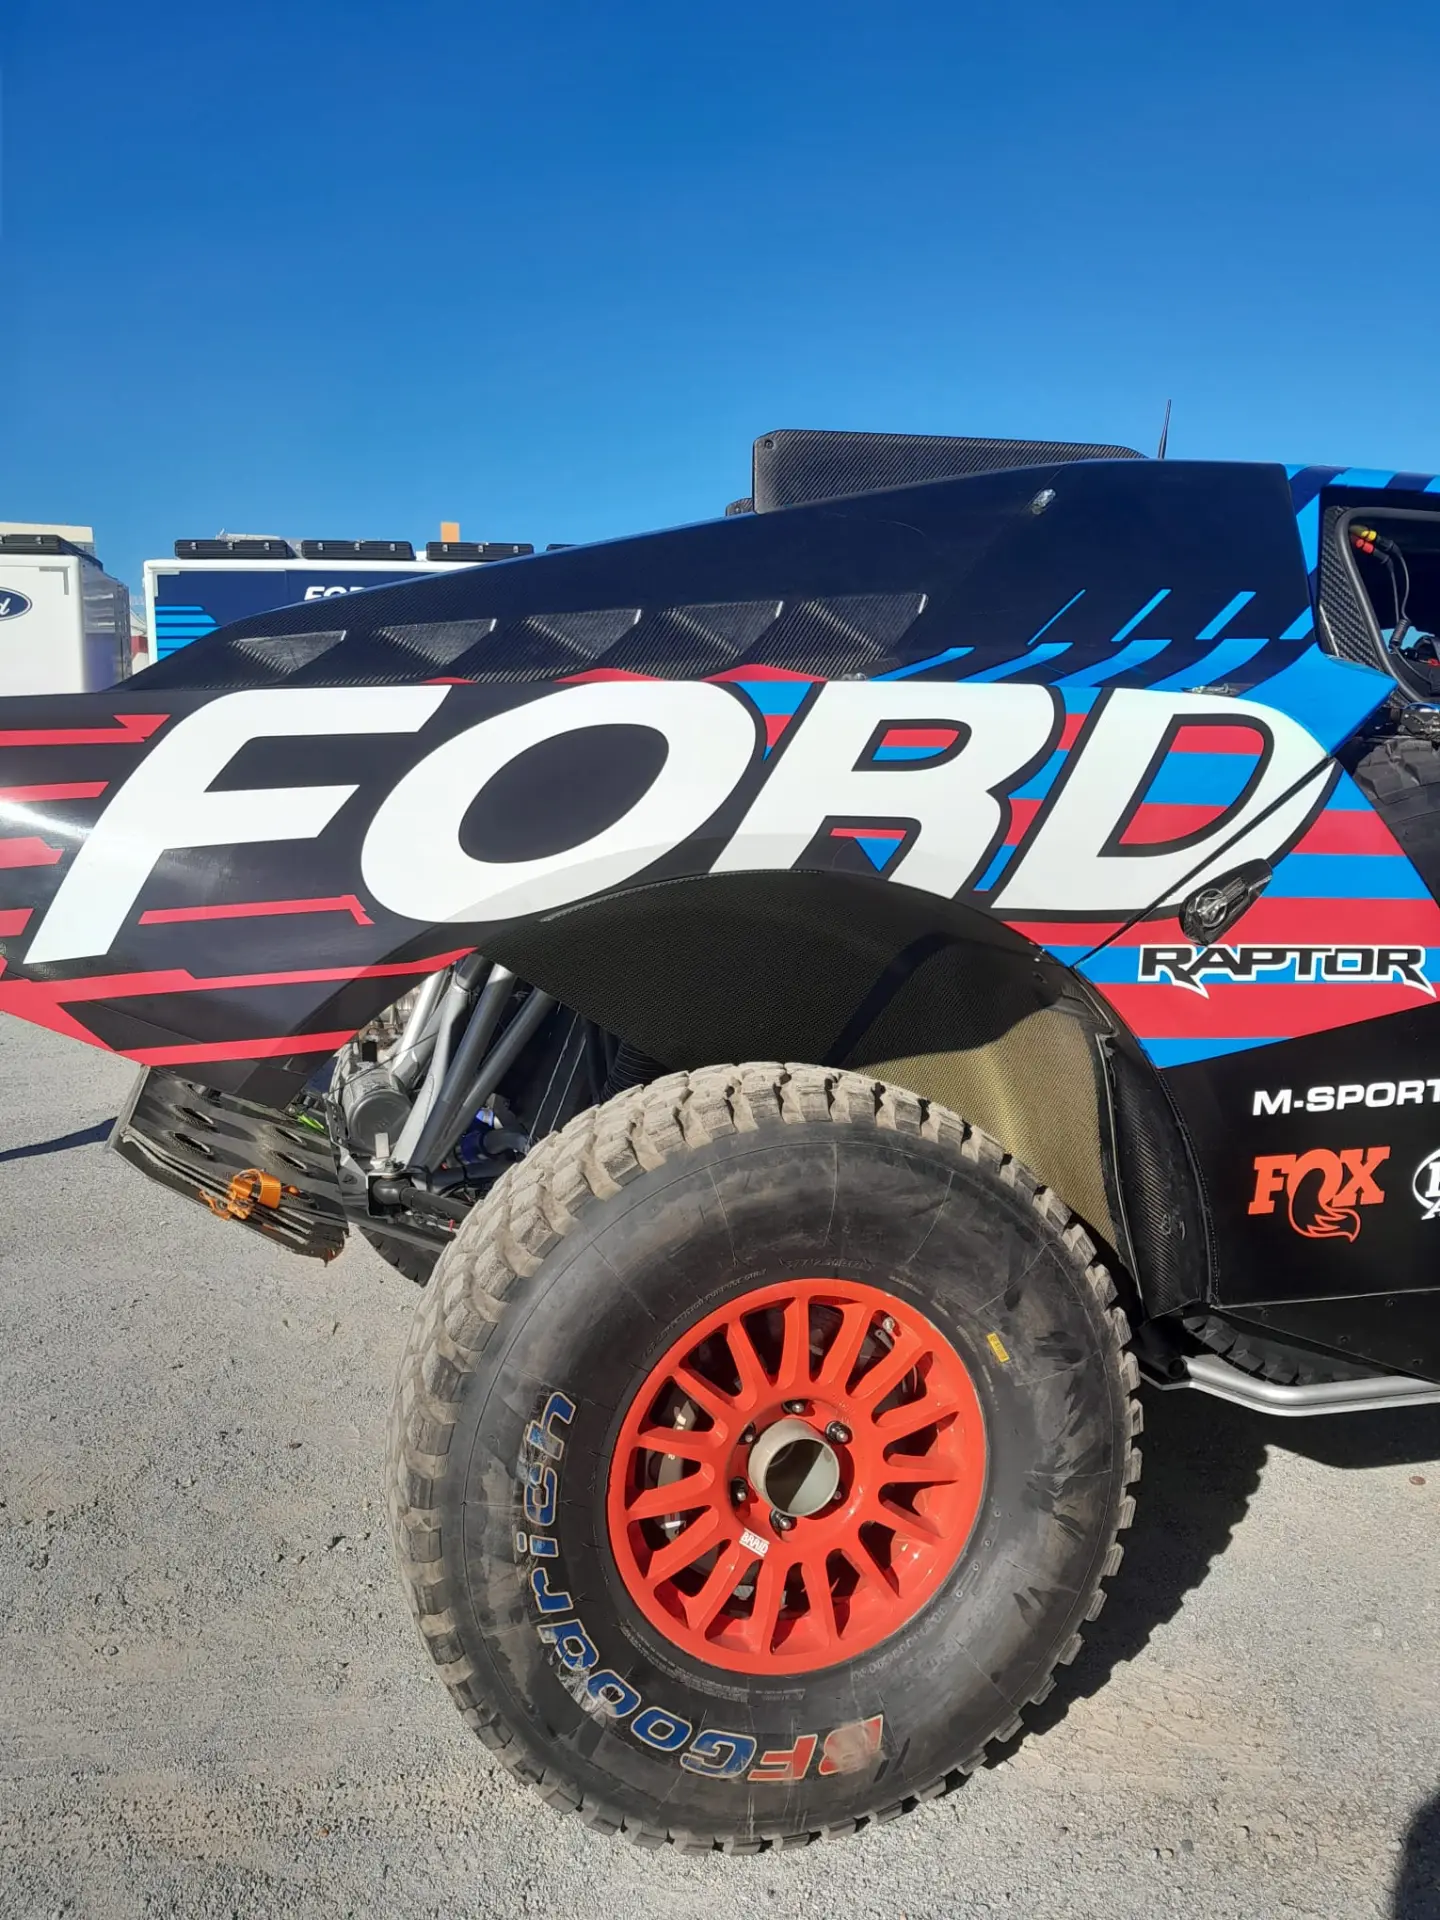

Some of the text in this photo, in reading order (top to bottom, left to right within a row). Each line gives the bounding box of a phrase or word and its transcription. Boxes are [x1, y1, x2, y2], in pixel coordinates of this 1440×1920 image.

[23, 680, 1338, 965] FORD
[1138, 943, 1437, 999] RAPTOR
[1252, 1078, 1440, 1116] M-SPORT
[1248, 1146, 1391, 1243] FOX
[740, 1529, 769, 1556] BRAID
